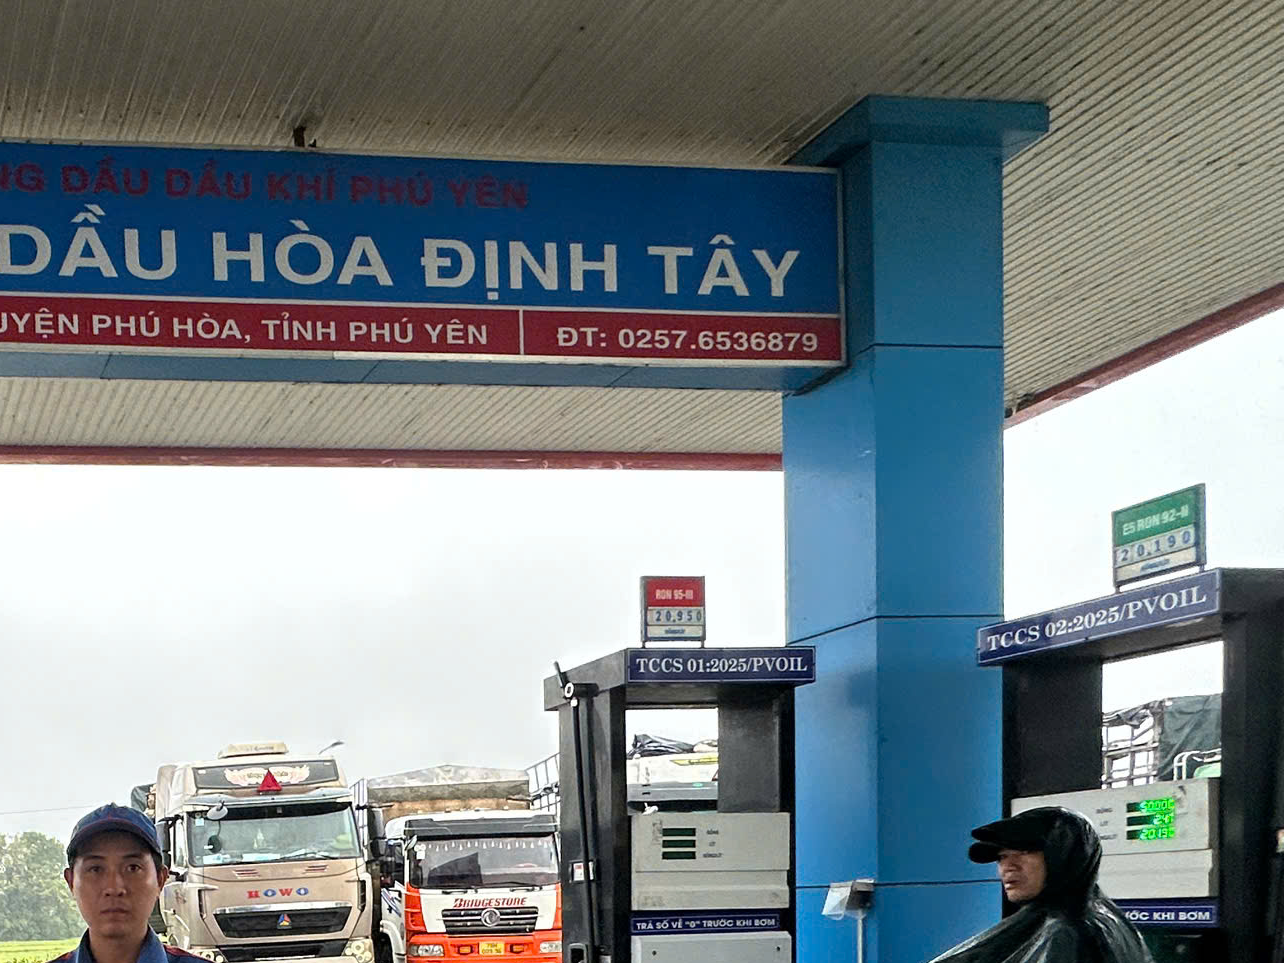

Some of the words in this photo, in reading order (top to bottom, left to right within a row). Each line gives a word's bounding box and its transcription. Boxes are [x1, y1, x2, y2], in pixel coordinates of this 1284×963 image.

[267, 167, 336, 203] KHÍ
[447, 174, 529, 209] YÊN
[213, 219, 393, 286] HÒA
[421, 238, 617, 300] ĐỊNH
[647, 234, 800, 297] TÂY
[92, 311, 160, 337] PHÚ
[173, 313, 250, 343] HÒA,
[261, 312, 336, 342] TỈNH
[349, 317, 413, 343] PHÚ
[425, 319, 487, 344] YÊN
[557, 326, 607, 347] ĐT:
[618, 328, 818, 351] 0257.6536879
[987, 624, 1040, 652] TCCS
[1044, 585, 1207, 639] 02:2025/PVOIL
[636, 657, 683, 673] TCCS
[687, 656, 808, 673] 01:2025/PVOIL
[247, 887, 309, 899] HOWO
[453, 897, 527, 908] BRIDGESTONE
[736, 919, 752, 927] KHI
[1153, 911, 1175, 920] KHI
[1178, 910, 1210, 920] BƠM
